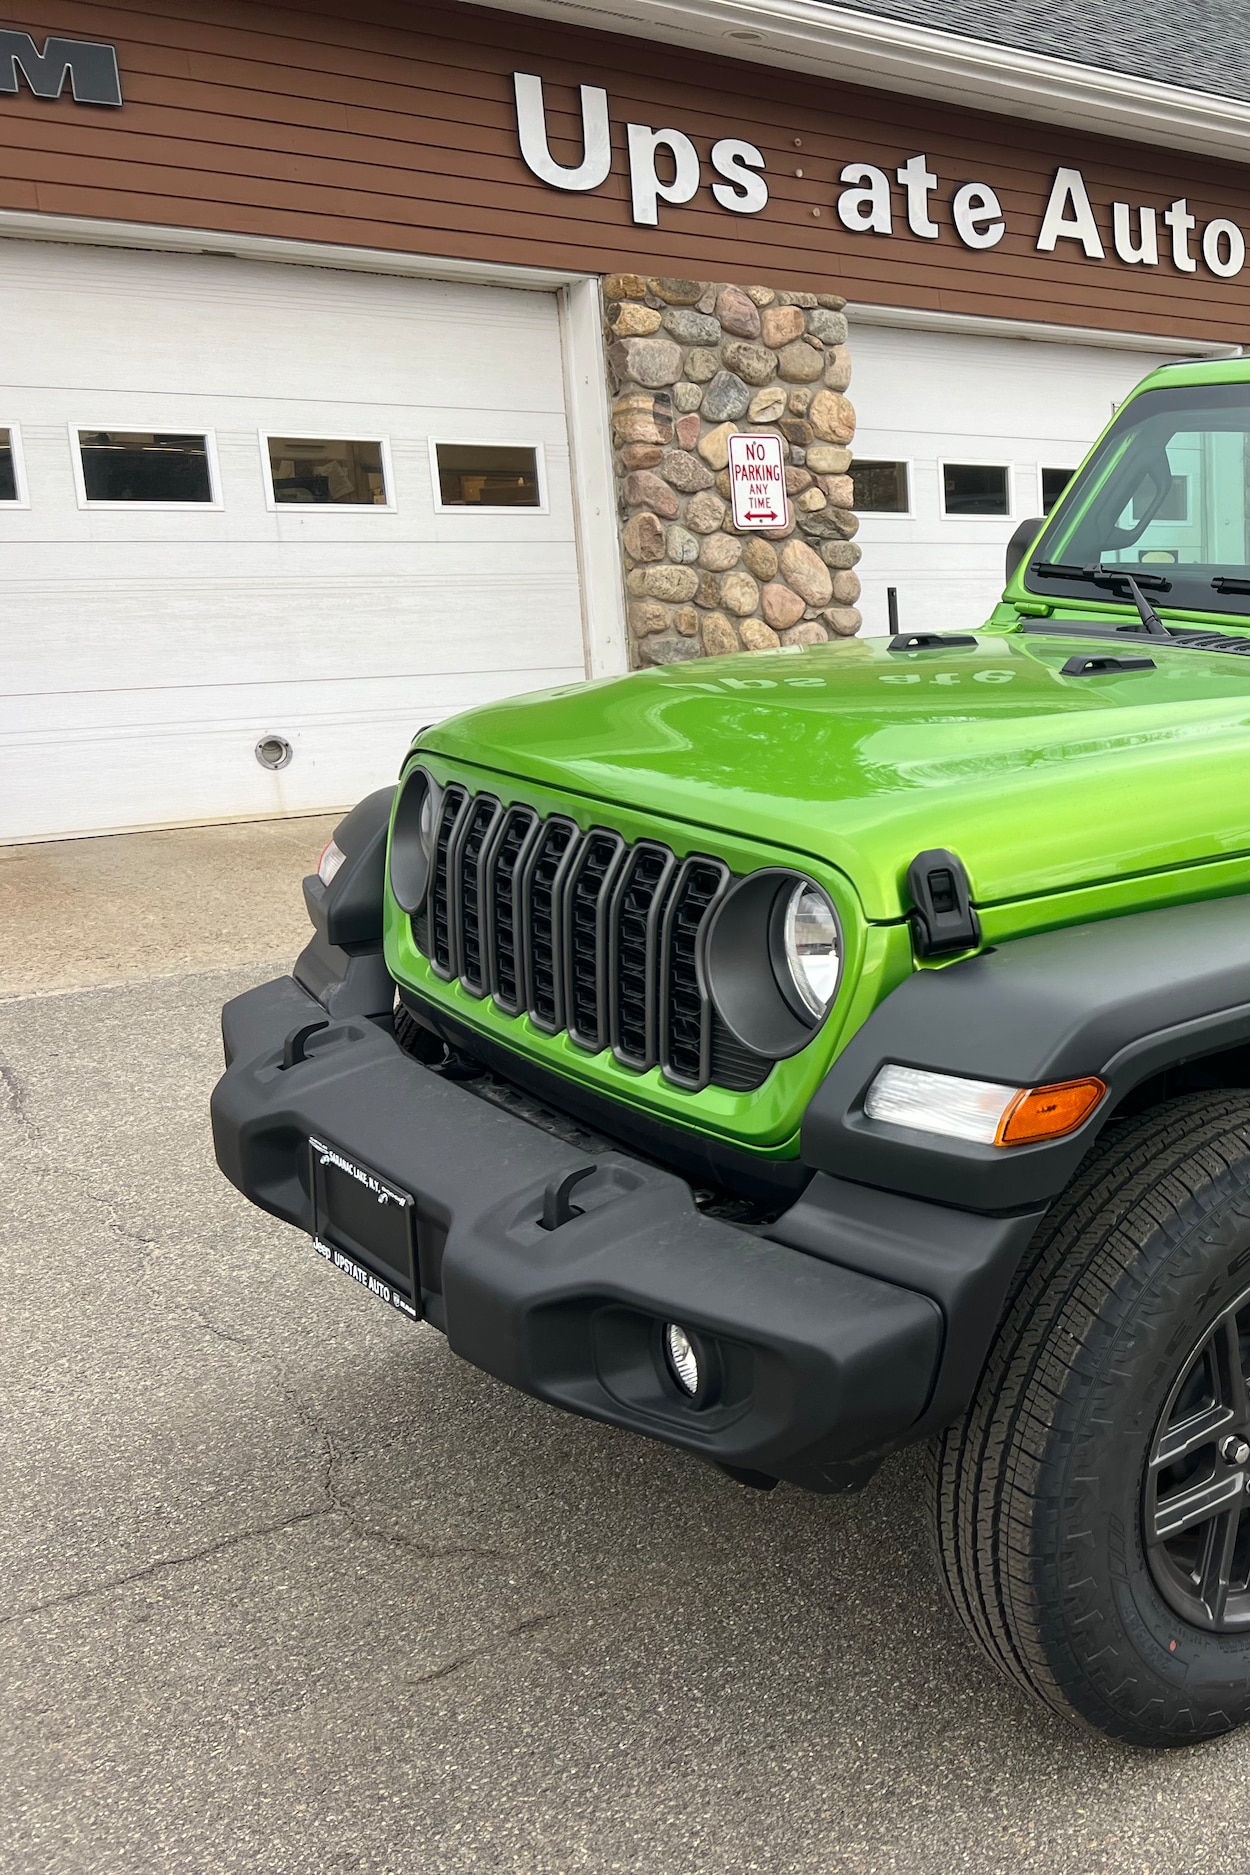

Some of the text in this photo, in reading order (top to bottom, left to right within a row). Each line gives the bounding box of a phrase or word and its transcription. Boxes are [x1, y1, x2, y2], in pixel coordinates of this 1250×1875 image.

[512, 71, 1247, 279] Ups ate Auto
[746, 444, 765, 460] NO
[735, 465, 779, 481] PARKING
[749, 483, 769, 495] ANY
[749, 497, 771, 508] TIME
[328, 1150, 354, 1176] SARANAC
[313, 1236, 391, 1302] Jeep UPSTATE AUTO
